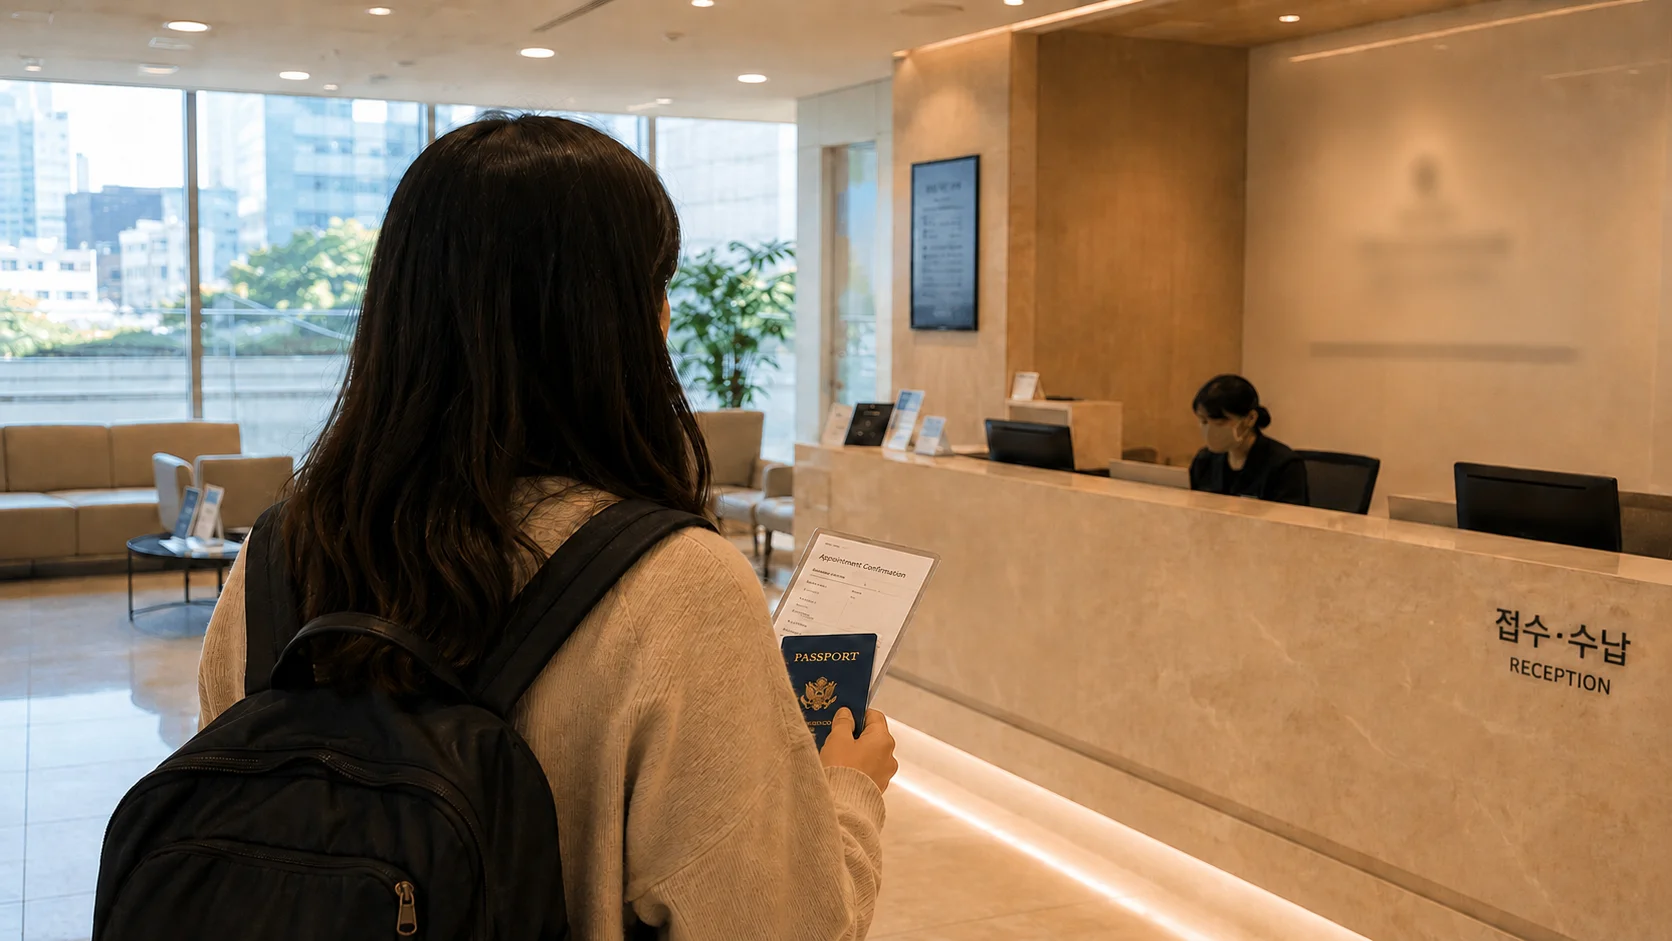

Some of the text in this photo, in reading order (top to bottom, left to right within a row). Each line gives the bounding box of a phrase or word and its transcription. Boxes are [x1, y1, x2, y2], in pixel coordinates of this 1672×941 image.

[819, 553, 906, 578] Appointment Confirmation
[1496, 608, 1631, 666] 접수·수납
[794, 651, 860, 662] PASSPORT
[1510, 657, 1610, 695] RECEPTION
